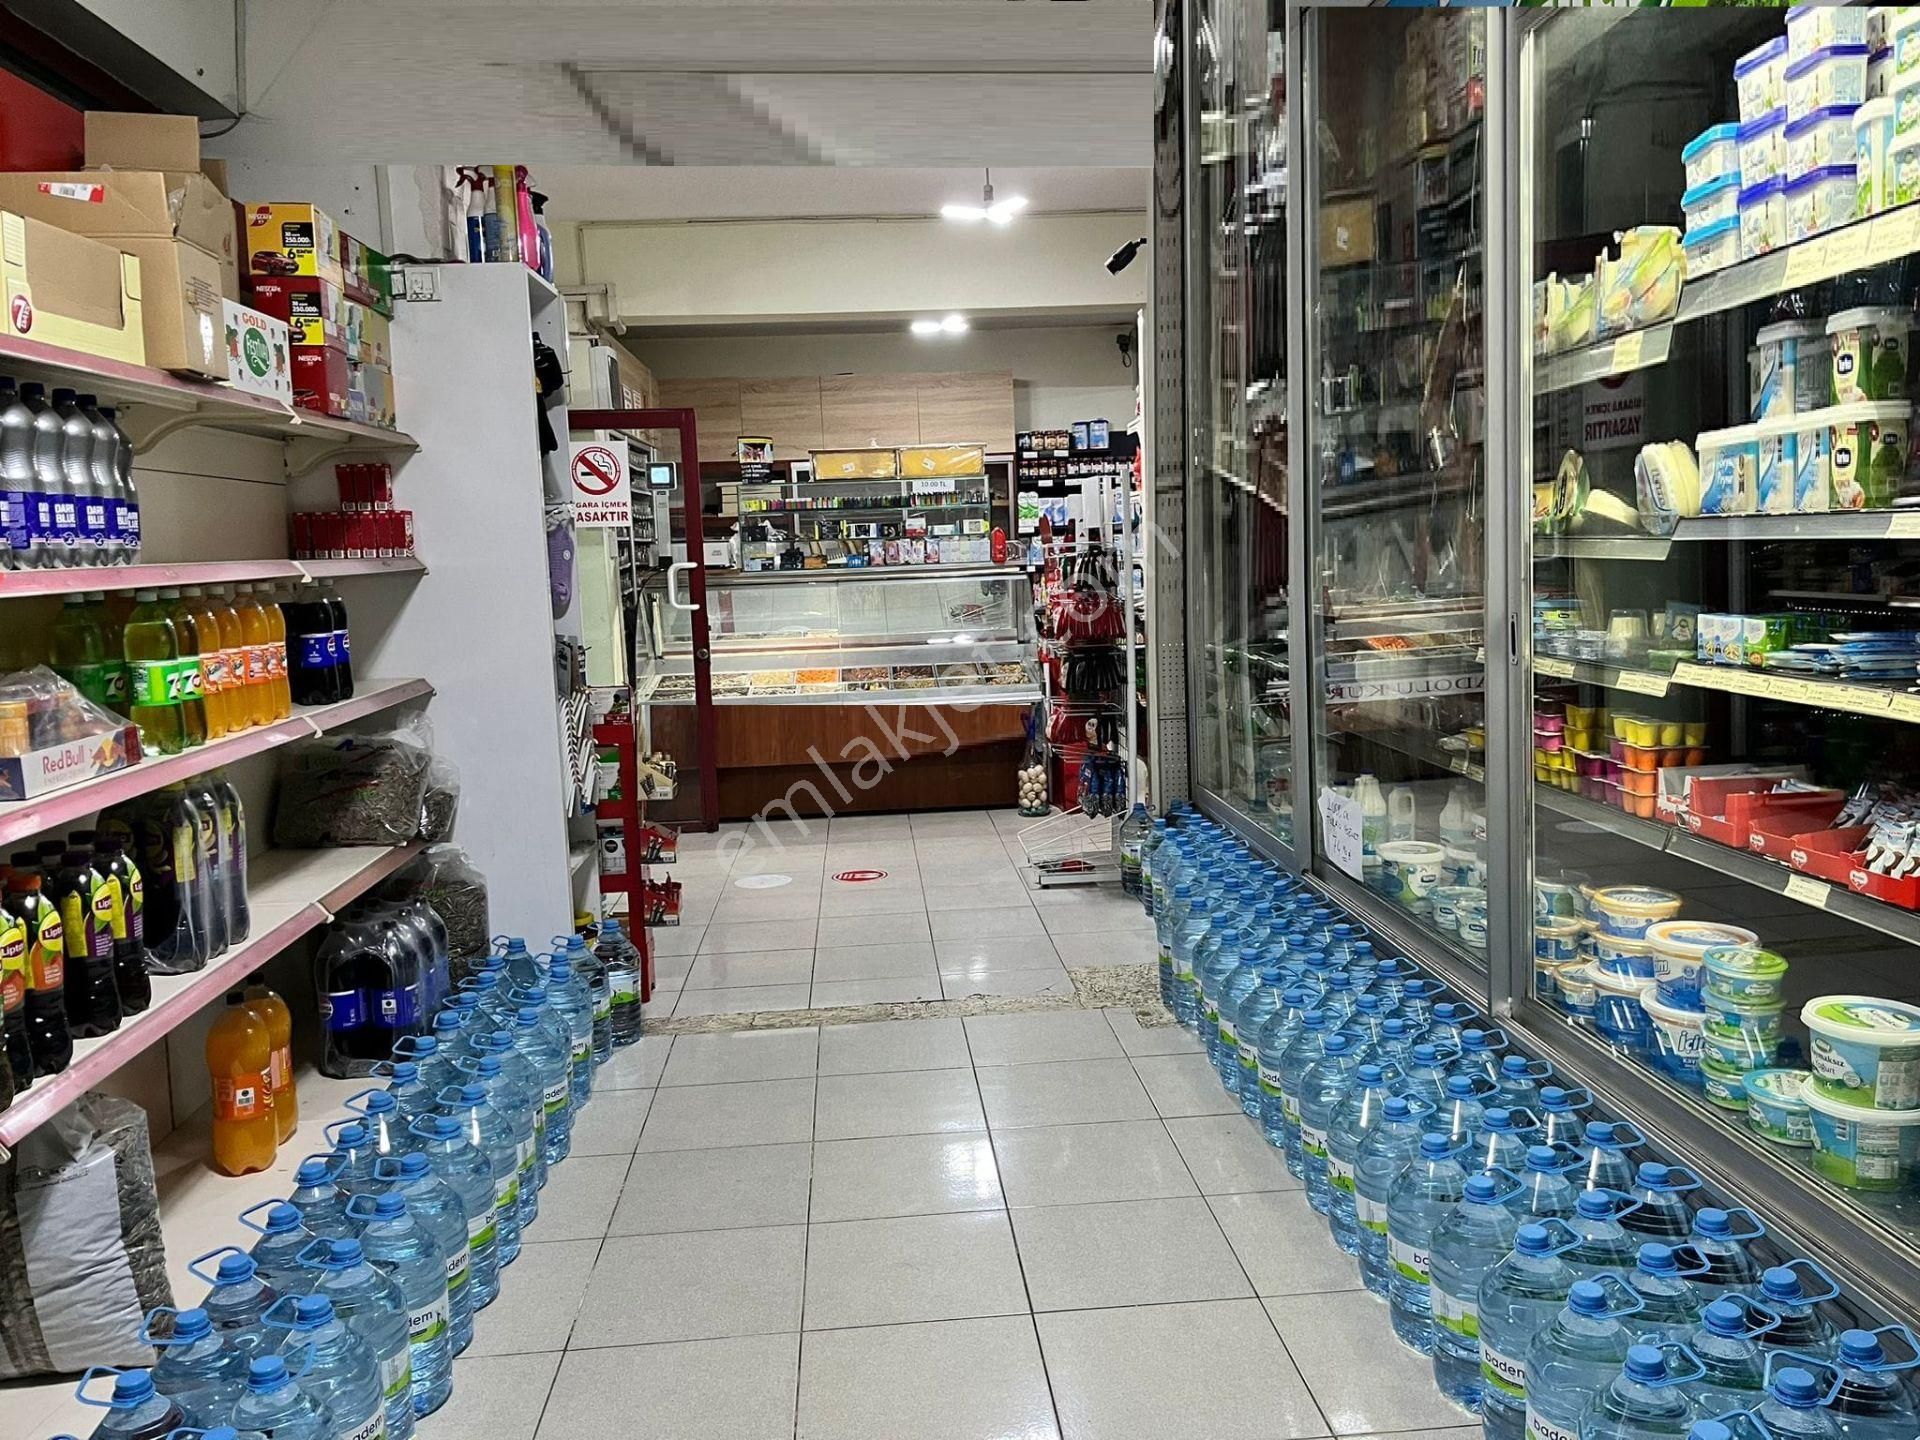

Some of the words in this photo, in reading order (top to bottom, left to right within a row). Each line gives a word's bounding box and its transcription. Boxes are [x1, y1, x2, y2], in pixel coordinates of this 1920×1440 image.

[242, 313, 267, 331] GOLD
[601, 501, 628, 509] İÇMEK
[576, 511, 628, 522] ASAKTIR
[42, 755, 65, 775] Red
[65, 745, 85, 770] Bull
